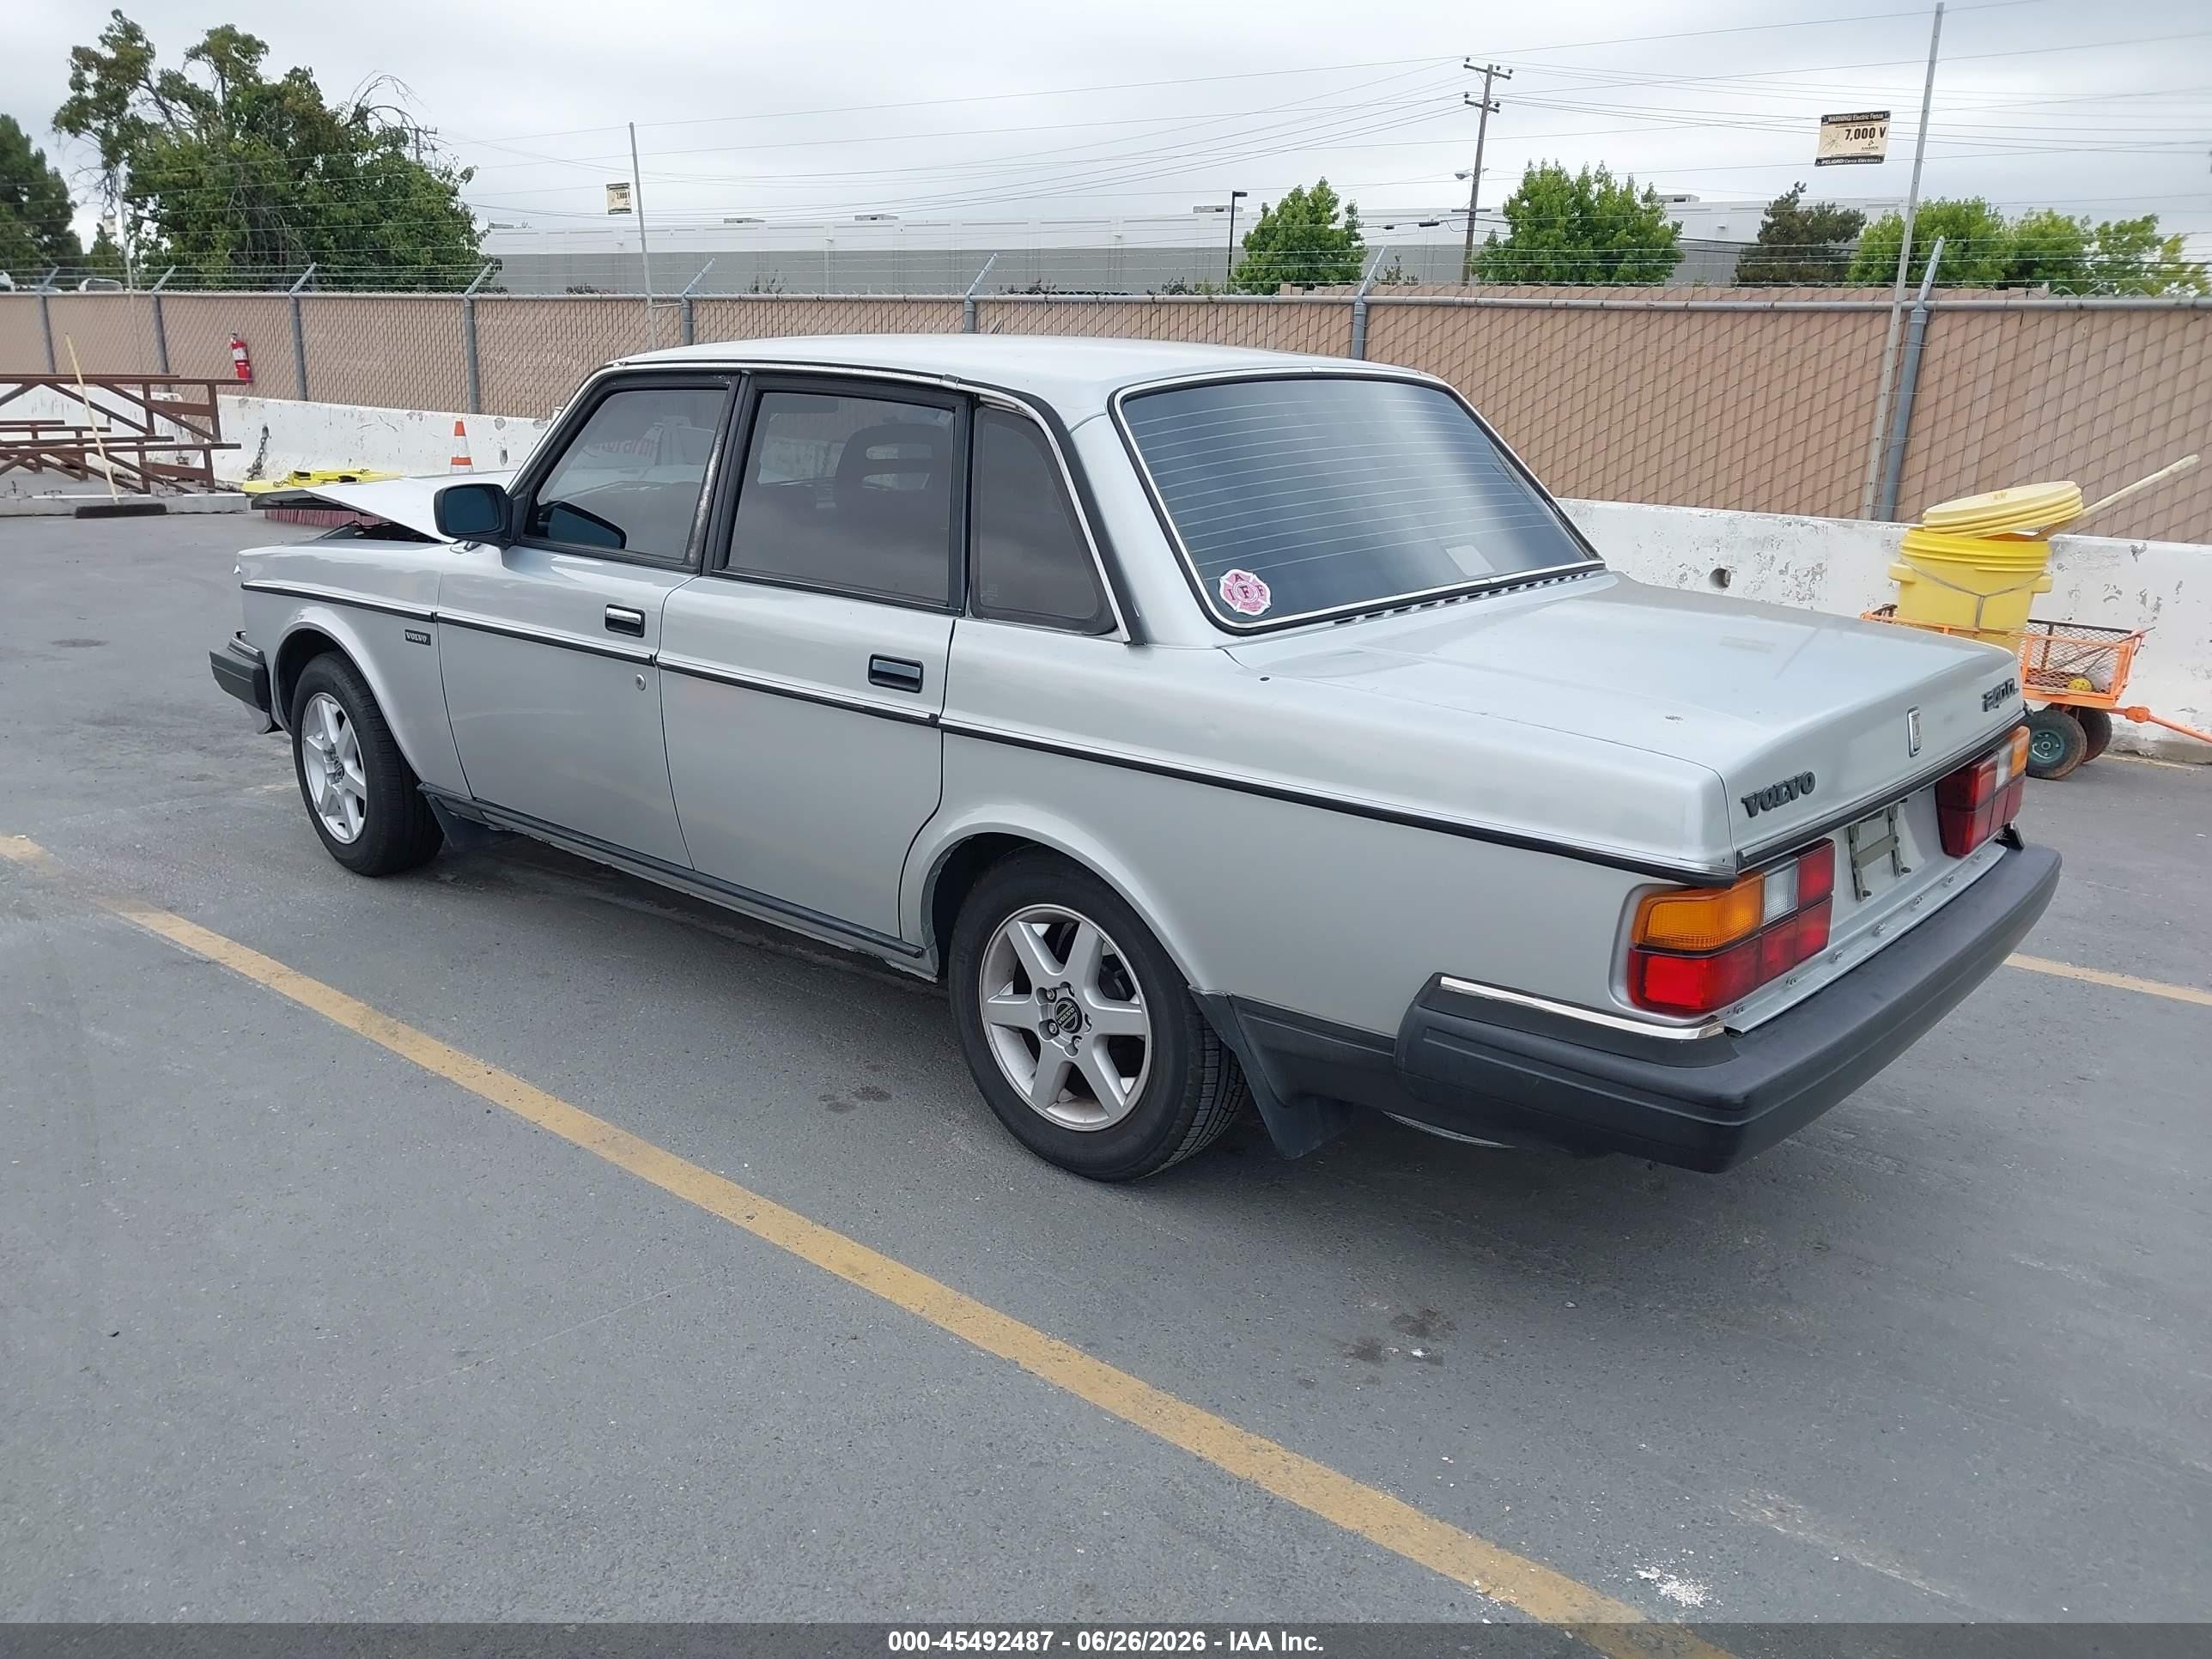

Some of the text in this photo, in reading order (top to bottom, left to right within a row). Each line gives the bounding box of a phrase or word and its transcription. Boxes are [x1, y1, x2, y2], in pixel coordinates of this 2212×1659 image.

[1845, 127, 1887, 142] 7,000 V
[1235, 574, 1244, 582] A
[1240, 585, 1250, 599] F
[1255, 585, 1264, 597] F
[406, 632, 427, 643] VOLVO
[1741, 770, 1816, 818] VOLVO
[1058, 1007, 1075, 1024] VOLVO
